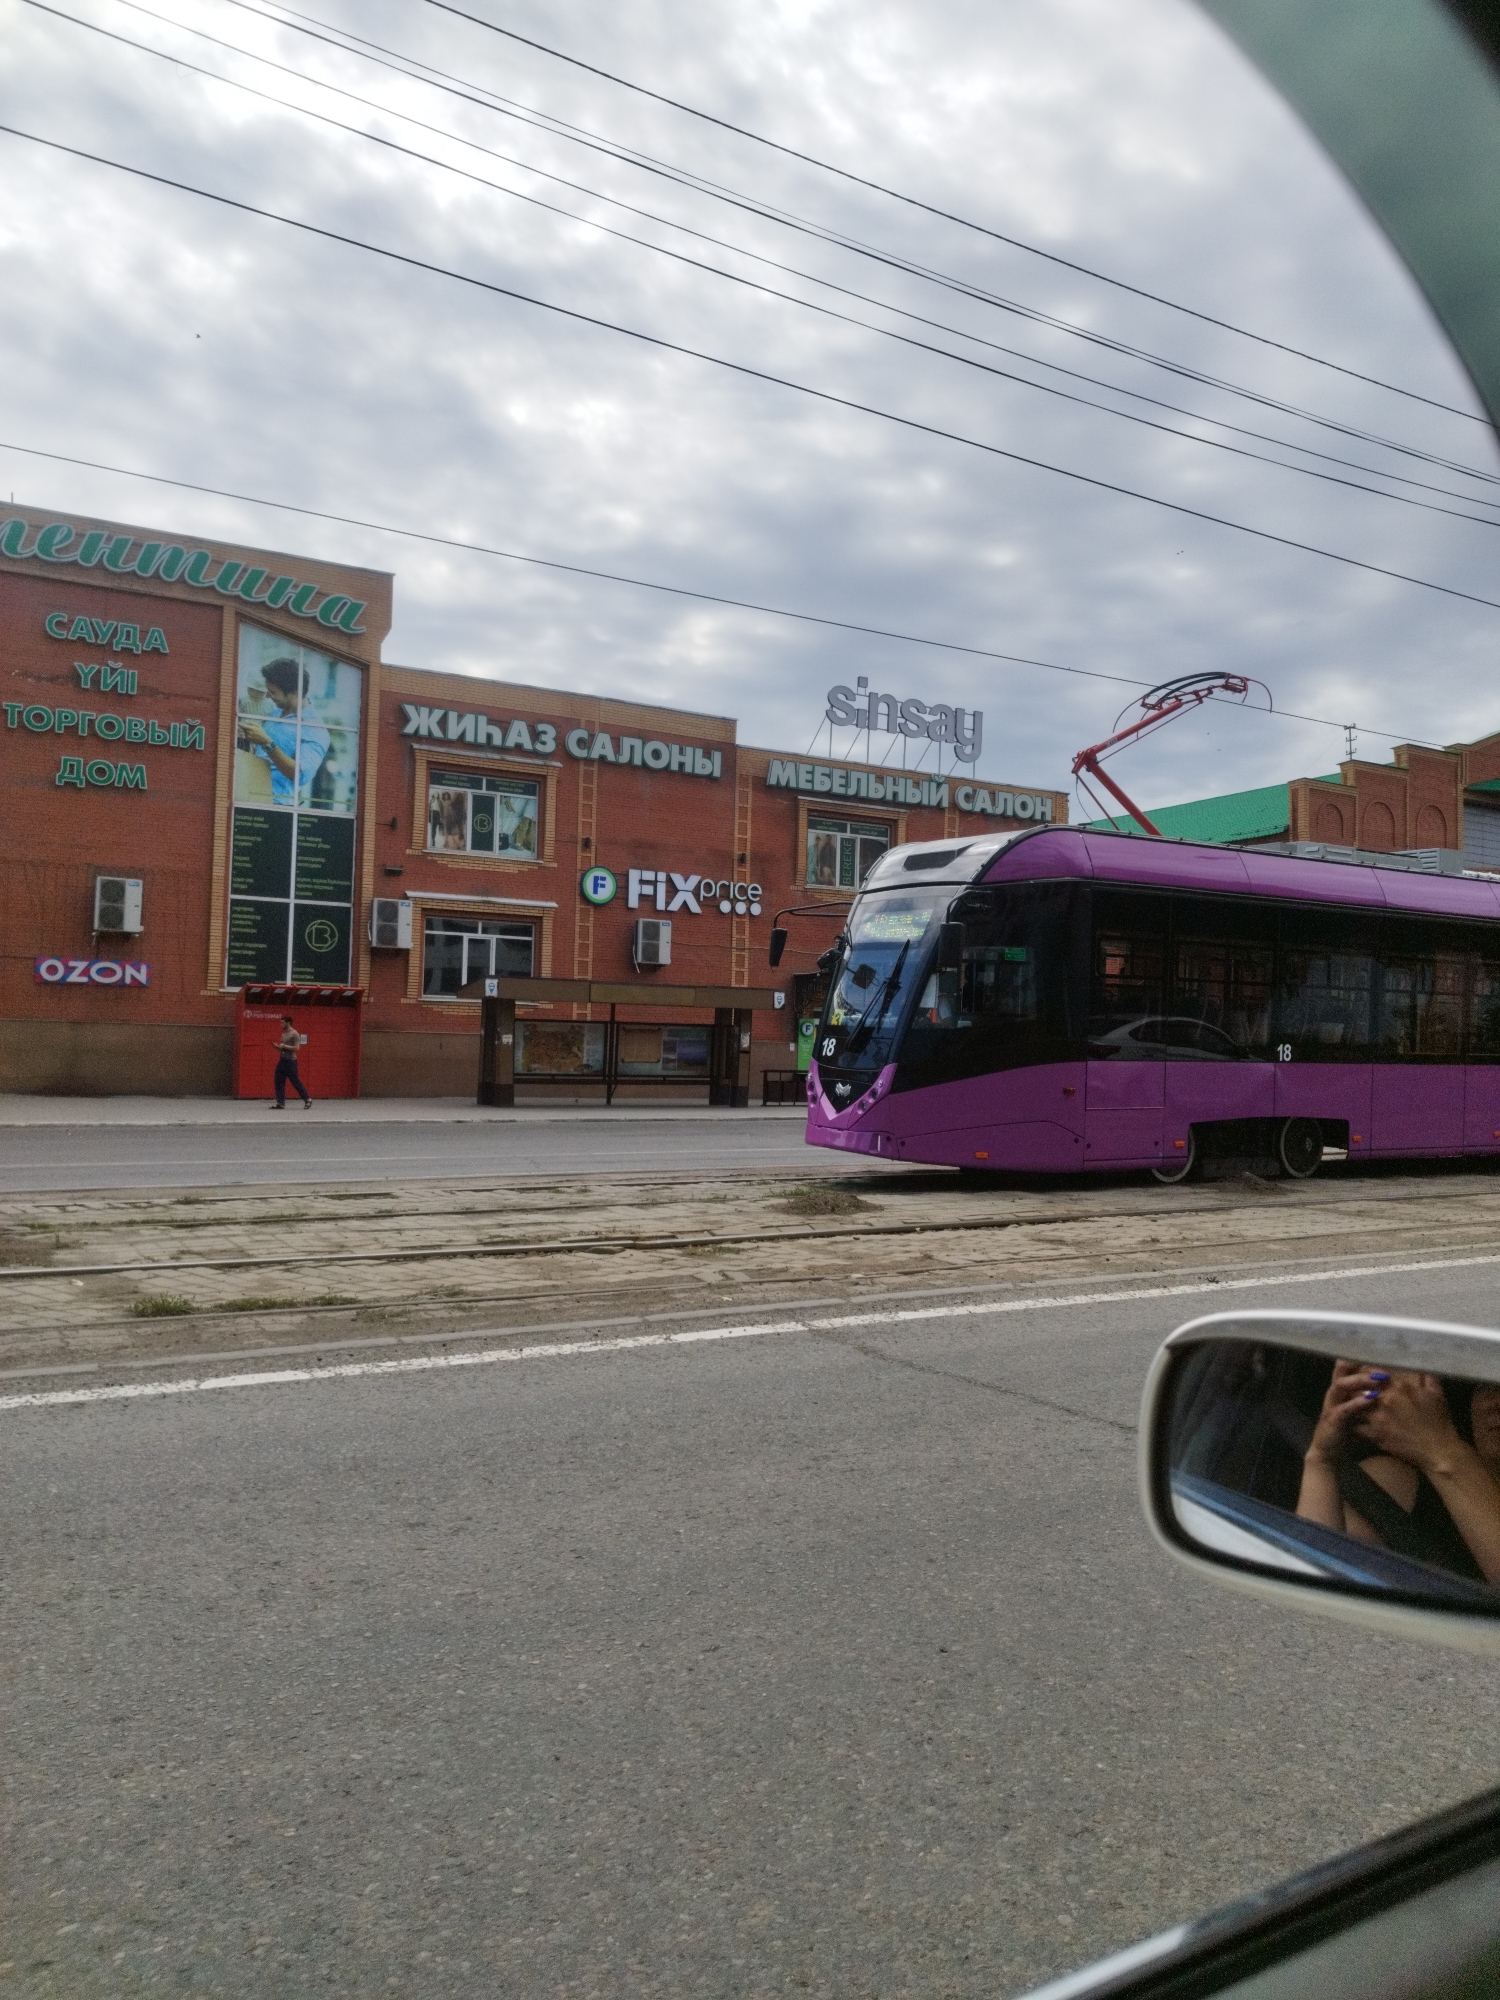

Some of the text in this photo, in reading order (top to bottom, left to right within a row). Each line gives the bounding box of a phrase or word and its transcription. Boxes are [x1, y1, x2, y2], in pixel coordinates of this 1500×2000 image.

[45, 612, 169, 654] САУДА
[2, 702, 206, 750] ТОРГОВЫЙ
[825, 676, 983, 763] sinsay
[565, 727, 722, 778] САЛОНЫ
[56, 756, 148, 790] ДОМ
[766, 758, 1053, 821] МЕБЕЛЬНЫЙ САЛОН
[842, 839, 852, 884] BEREKE
[593, 875, 607, 895] F
[700, 878, 763, 902] price
[40, 959, 147, 985] OZON
[822, 1037, 836, 1056] 18
[1277, 1043, 1292, 1062] 18
